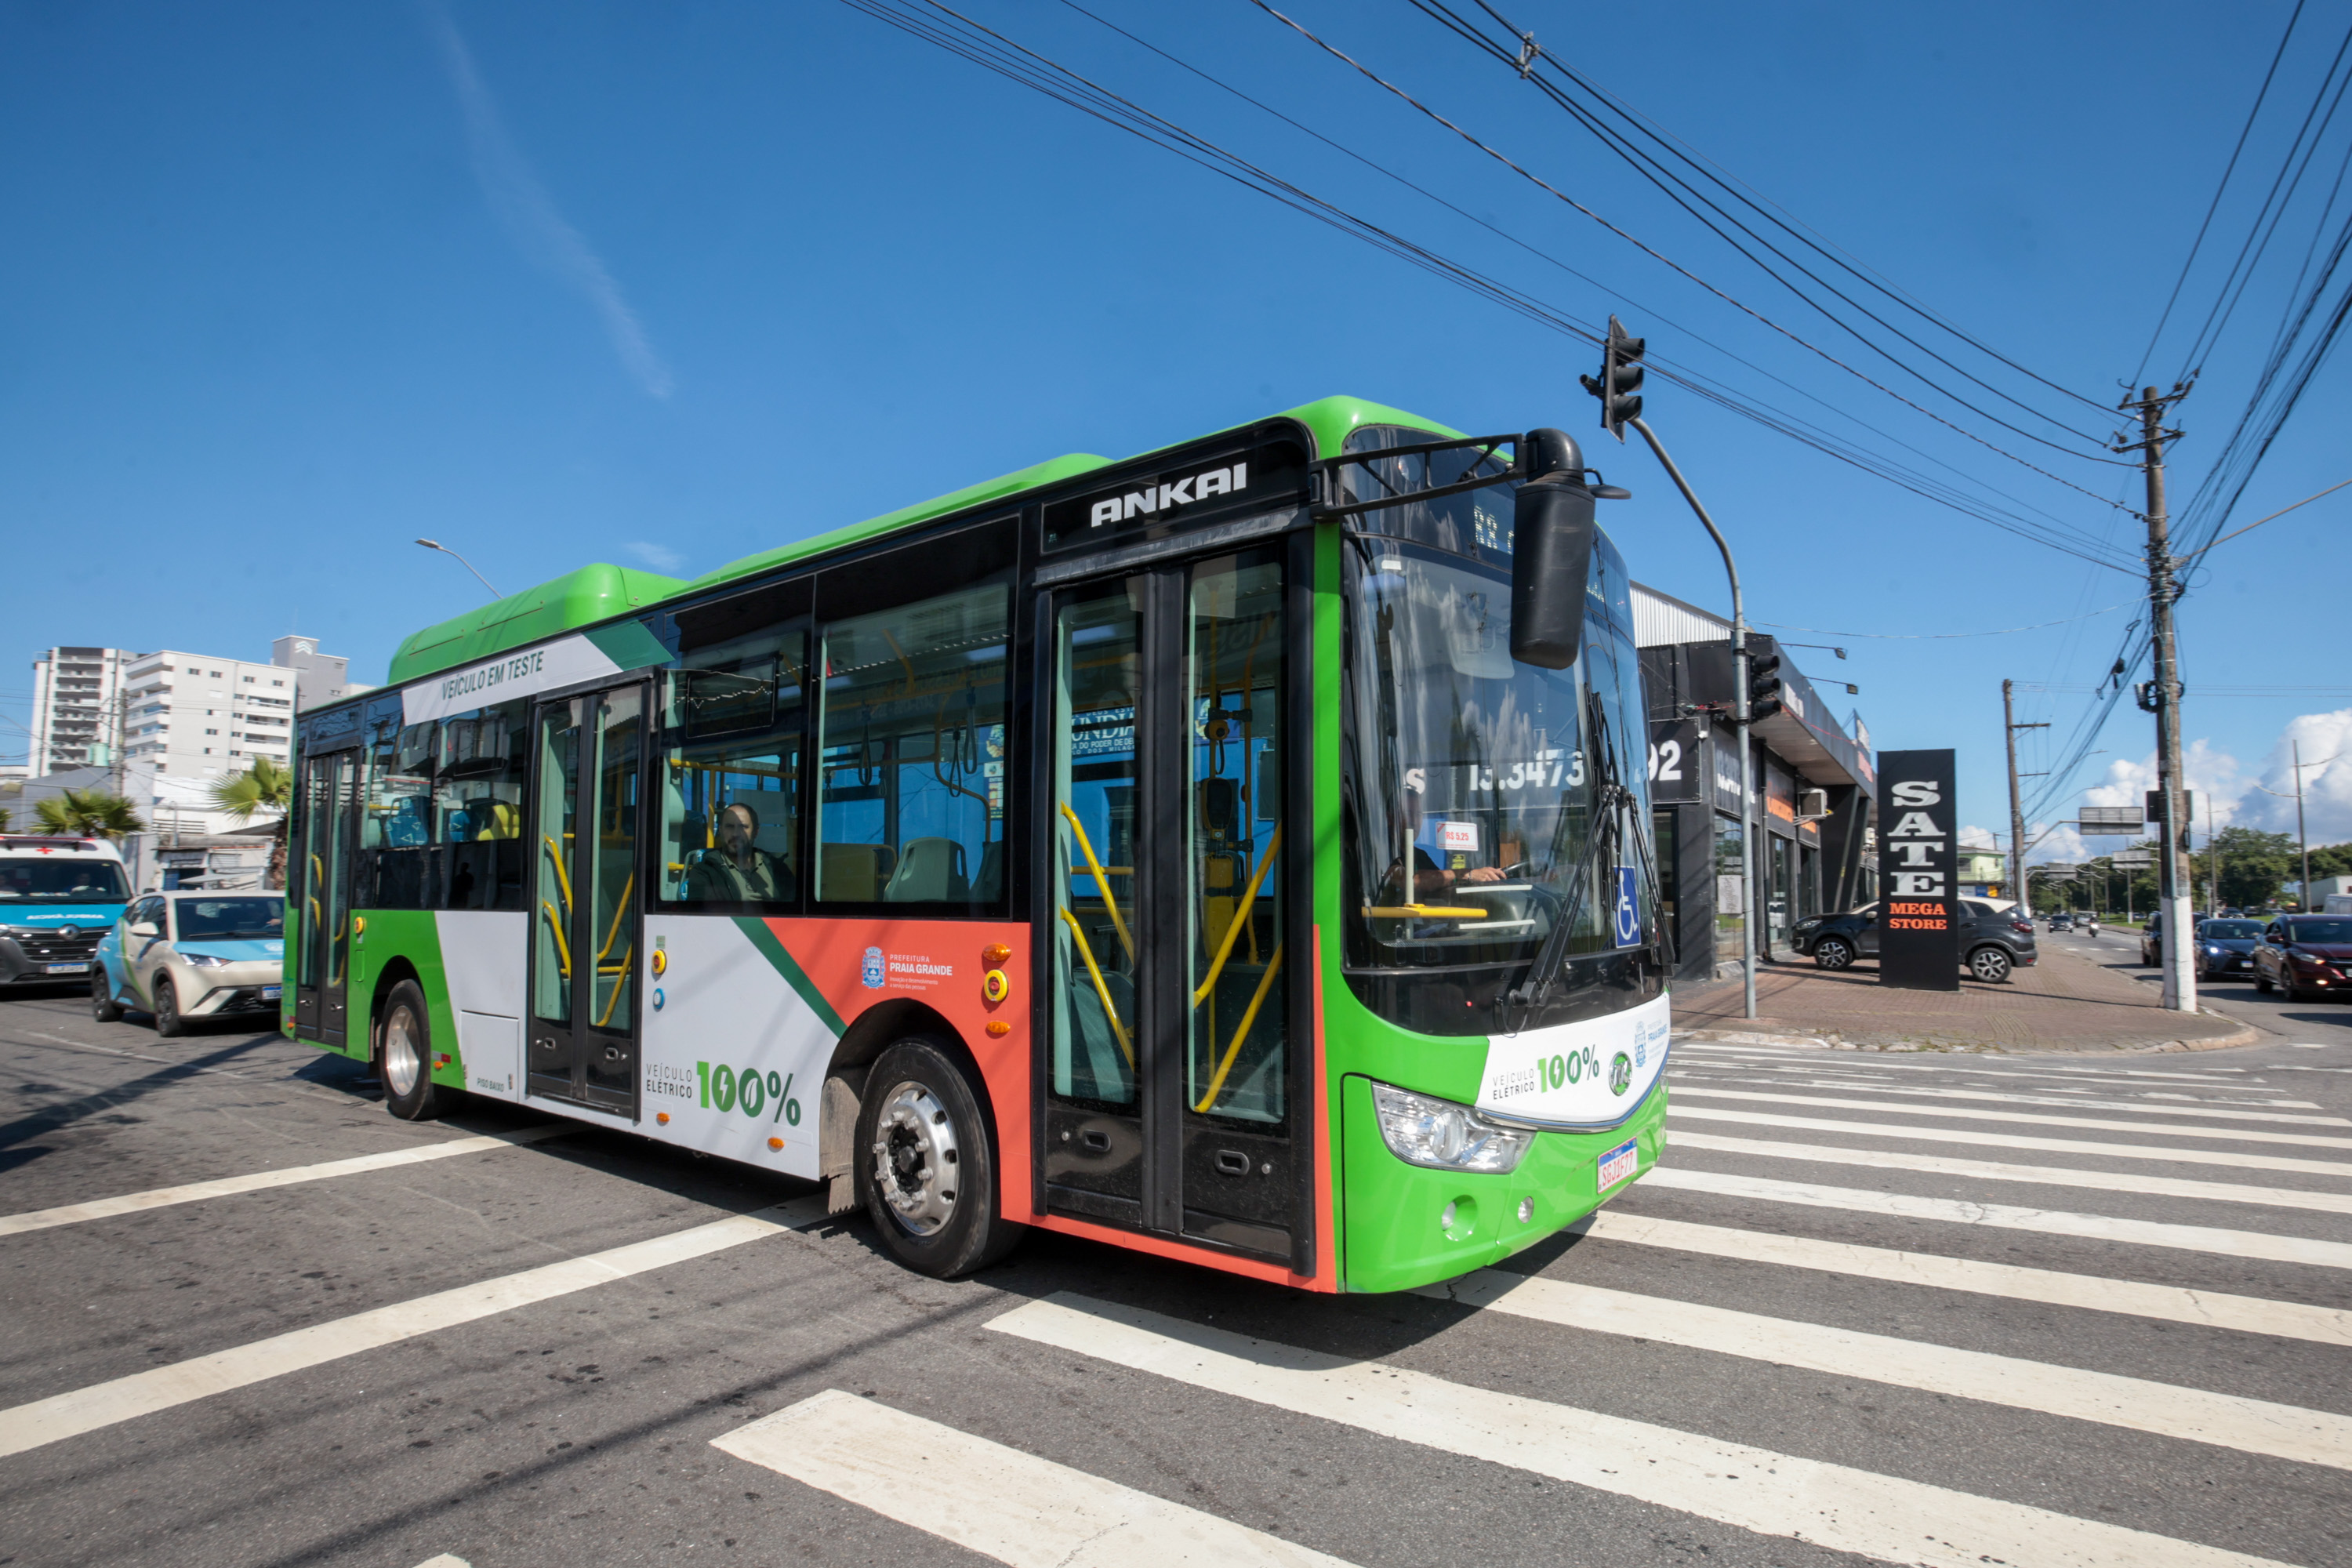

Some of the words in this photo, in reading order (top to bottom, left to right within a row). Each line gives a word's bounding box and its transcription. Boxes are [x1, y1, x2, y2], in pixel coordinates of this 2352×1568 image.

[1091, 462, 1247, 528] ANKAI
[442, 672, 485, 700] VEÍCULO
[488, 663, 505, 687] EM
[508, 651, 544, 681] TESTE
[1091, 739, 1112, 748] PODER
[1446, 831, 1454, 840] R$
[1887, 781, 1947, 896] SATE
[1889, 902, 1947, 915] MEGA
[1889, 918, 1947, 930] STORE
[890, 954, 930, 963] PREFEITURA
[890, 962, 915, 973] PRAIA
[916, 964, 953, 976] GRANDE
[1493, 1068, 1534, 1087] VEÍCULO
[1537, 1044, 1599, 1094] 100%
[647, 1079, 692, 1098] ELÉTRICO
[647, 1062, 692, 1082] VEÍCULO
[697, 1061, 801, 1127] 100%
[1493, 1081, 1534, 1100] ELÉTRICO
[1602, 1151, 1633, 1186] SGJ1F77
